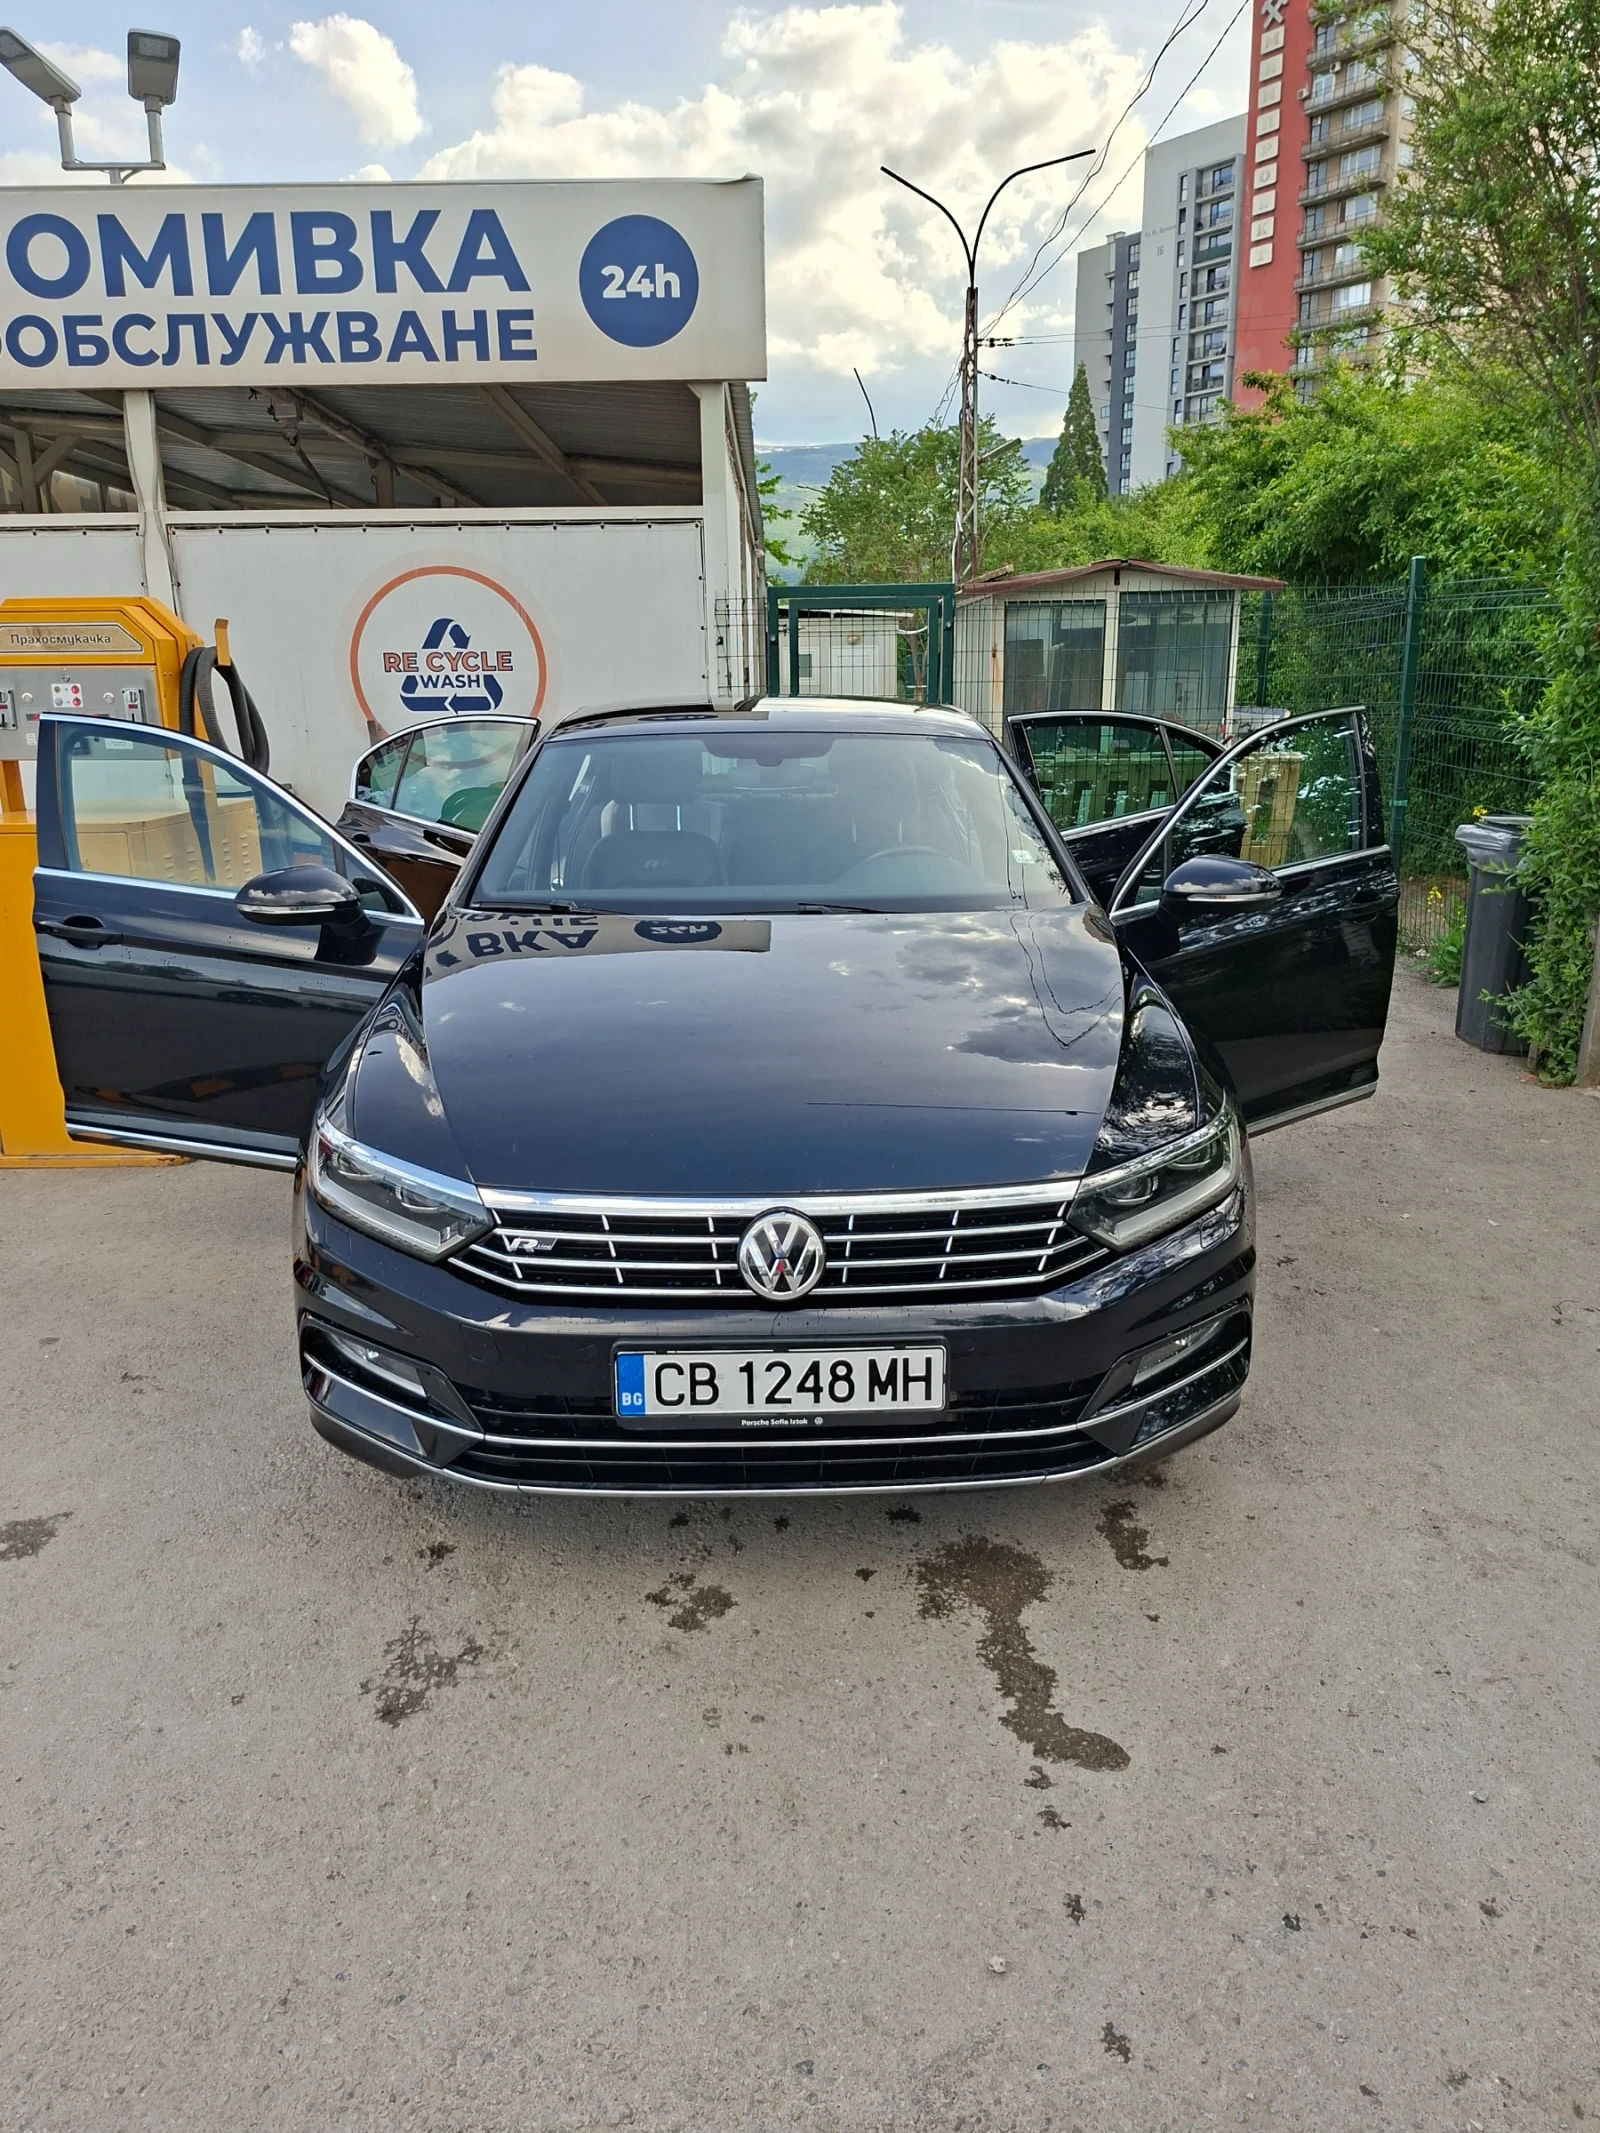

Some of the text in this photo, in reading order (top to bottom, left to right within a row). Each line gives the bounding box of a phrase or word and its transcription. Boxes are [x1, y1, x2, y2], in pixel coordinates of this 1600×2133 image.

[5, 208, 532, 300] ОМИВКА
[600, 263, 681, 299] 24h
[0, 308, 538, 369] ОБСЛУЖВАНЕ
[10, 633, 112, 646] Прахосмукачка
[382, 650, 514, 673] RE CYCLE
[419, 674, 481, 689] WASH
[621, 1355, 932, 1407] BG CB 1248 MH
[741, 1418, 770, 1426] Porsche
[770, 1417, 789, 1425] Sofia
[790, 1416, 808, 1425] Iztok
